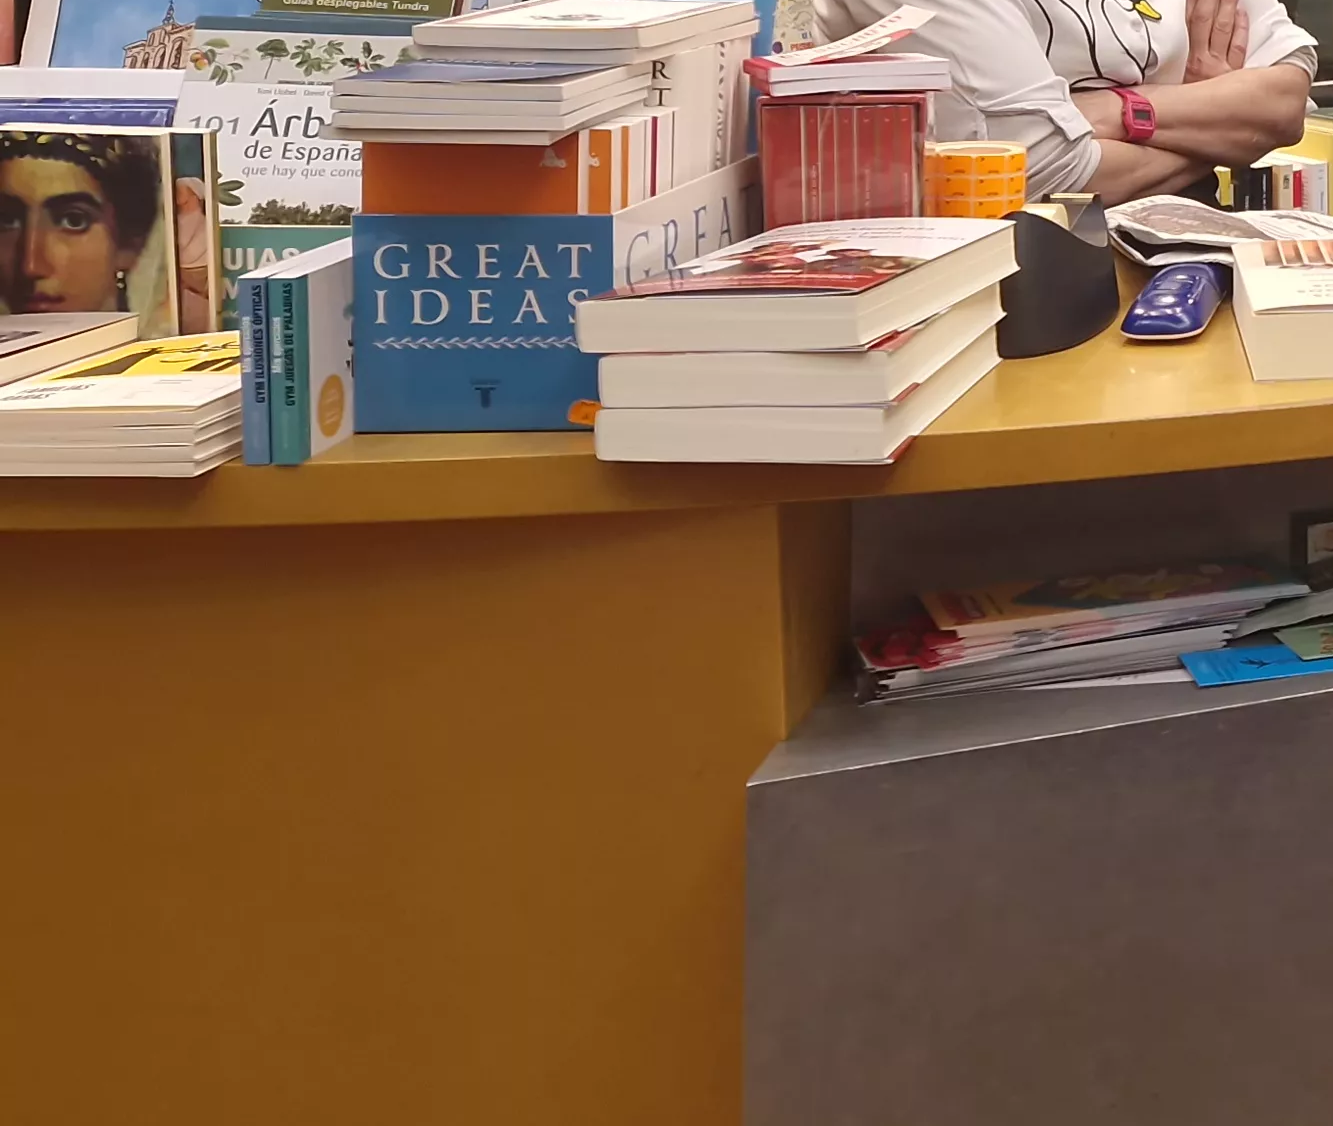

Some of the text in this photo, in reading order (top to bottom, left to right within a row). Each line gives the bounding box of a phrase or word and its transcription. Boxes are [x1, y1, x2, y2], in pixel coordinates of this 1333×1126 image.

[392, 0, 429, 11] Tundra
[189, 99, 327, 138] 101 Árb
[244, 140, 362, 164] de España
[242, 164, 325, 179] que hay que
[373, 243, 591, 280] GREAT
[374, 288, 591, 325] IDEAS
[251, 285, 266, 403] GYM ILUSIONES ÓPTICAS
[282, 283, 295, 406] GYM JUEGOS DE PALABRAS
